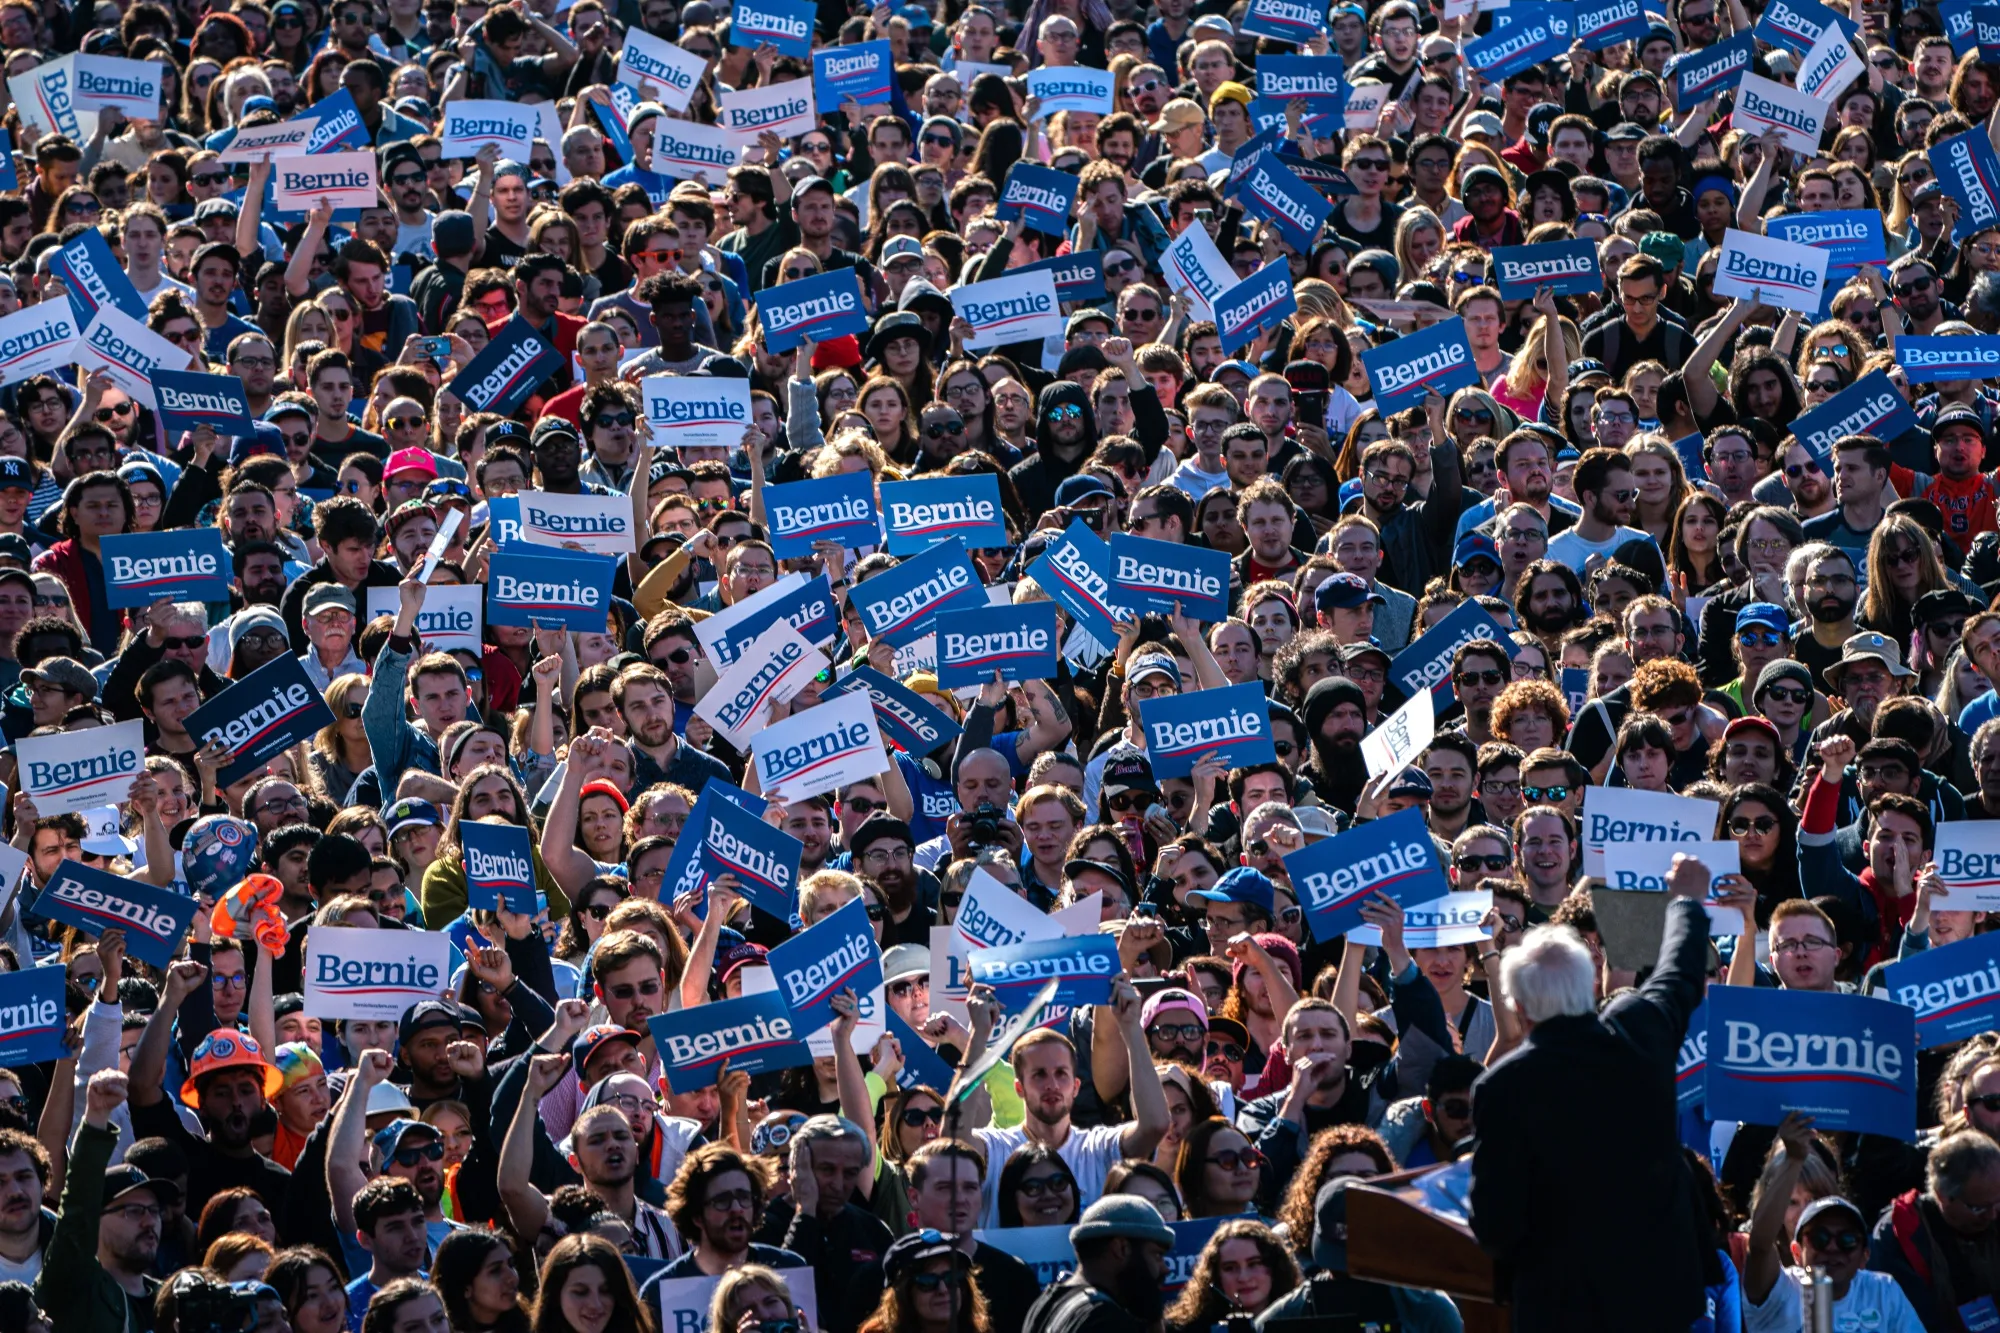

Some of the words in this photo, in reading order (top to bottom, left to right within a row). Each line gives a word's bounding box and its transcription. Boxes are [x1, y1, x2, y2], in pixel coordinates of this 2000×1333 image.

[736, 3, 807, 37] Bernie
[1256, 0, 1322, 26] Bernie
[1578, 0, 1639, 33] Bernie
[1768, 1, 1824, 40] Bern
[1475, 23, 1547, 68] Bernie
[78, 70, 154, 97] Bernie
[625, 45, 692, 90] Bernie
[824, 52, 879, 78] Bernie
[1262, 72, 1338, 94] Bernie
[1682, 48, 1748, 90] Bernie
[1033, 80, 1107, 98] Bernie
[450, 117, 527, 139] Bernie
[730, 98, 808, 126] Bernie
[1742, 89, 1817, 134] Bernie
[234, 128, 306, 148] Bernie
[659, 133, 735, 166] Bernie
[283, 168, 370, 190] Bernie
[1005, 179, 1067, 213] Bernie
[1954, 140, 1992, 225] Bernie
[1251, 168, 1316, 231] Bernie
[1785, 219, 1868, 243] Bernie
[1052, 264, 1096, 282] rnie
[1502, 254, 1592, 279] Bernie
[1724, 250, 1818, 287] Bernie
[765, 288, 856, 331] Bernie
[961, 293, 1050, 325] Bernie
[1220, 279, 1288, 334] Bernie
[0, 320, 72, 361] ernie
[1903, 347, 1999, 363] Bernie
[466, 336, 543, 410] Bernie
[1376, 343, 1466, 393] Bernie
[159, 383, 243, 417] Bernie
[651, 396, 745, 420] Bernie
[1806, 391, 1897, 455] Bernie
[527, 512, 626, 533] Bernie
[772, 494, 870, 536] Bernie
[889, 495, 997, 529] Bernie
[111, 548, 217, 581] Bernie
[1118, 555, 1220, 597] Bernie
[496, 575, 599, 606] Bernie
[867, 565, 969, 629] Bernie
[944, 623, 1048, 660] Bernie
[716, 639, 802, 729] Bernie
[844, 677, 939, 743] Bernie
[1151, 707, 1262, 748] Bernie
[30, 745, 136, 788] Bernie
[761, 720, 870, 779] Bernie
[469, 846, 530, 884] Bernie
[708, 817, 789, 887] Bernie
[1303, 840, 1428, 910] Bernie
[53, 878, 177, 936] Bernie
[1403, 907, 1482, 927] rnie
[315, 954, 438, 987] Bernie
[784, 930, 870, 1005] Bernie
[982, 950, 1110, 980] Bernie
[1897, 958, 2000, 1015] Berni
[0, 994, 58, 1031] rnie
[665, 1015, 793, 1066] Bernie
[1724, 1019, 1902, 1081] Bernie
